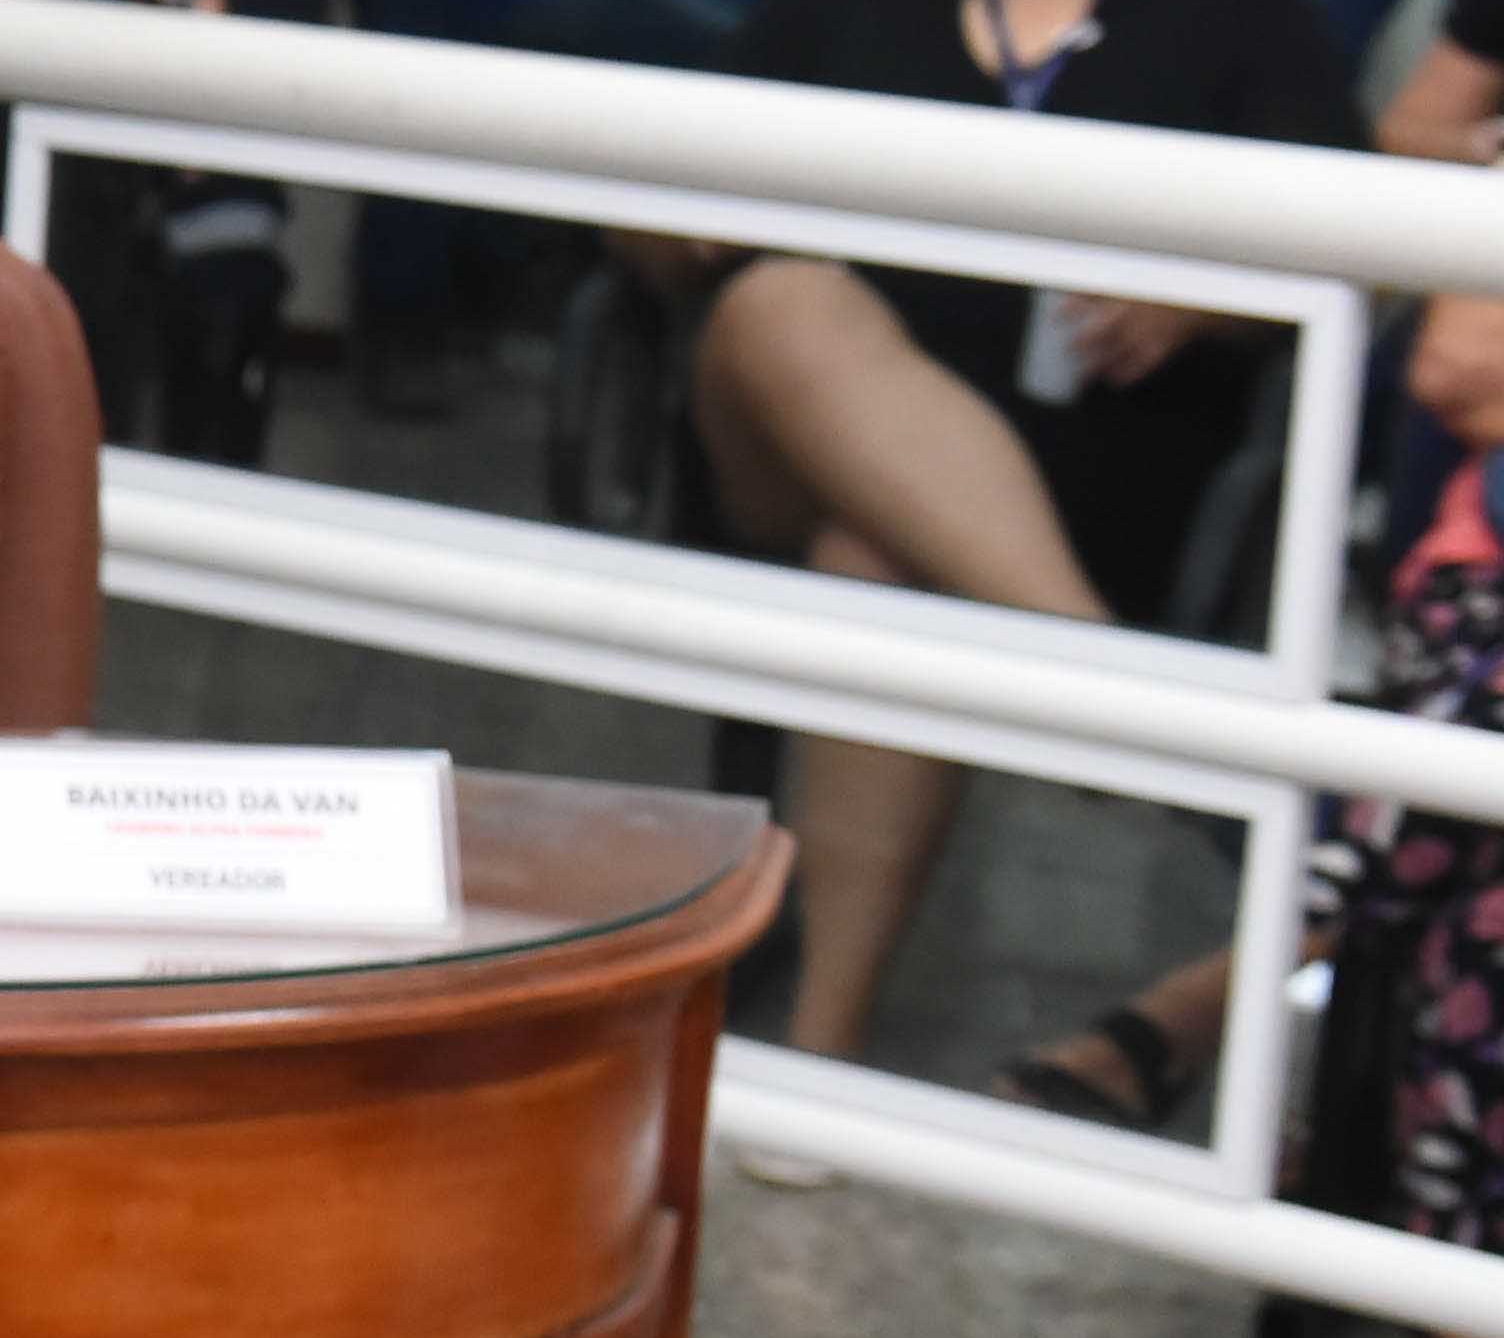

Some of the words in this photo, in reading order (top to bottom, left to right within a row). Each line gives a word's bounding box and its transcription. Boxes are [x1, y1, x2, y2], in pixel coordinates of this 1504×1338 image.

[66, 782, 227, 812] BAIXINHO
[240, 787, 283, 812] DA
[291, 789, 360, 814] VAN
[149, 867, 287, 892] VEREADOR
